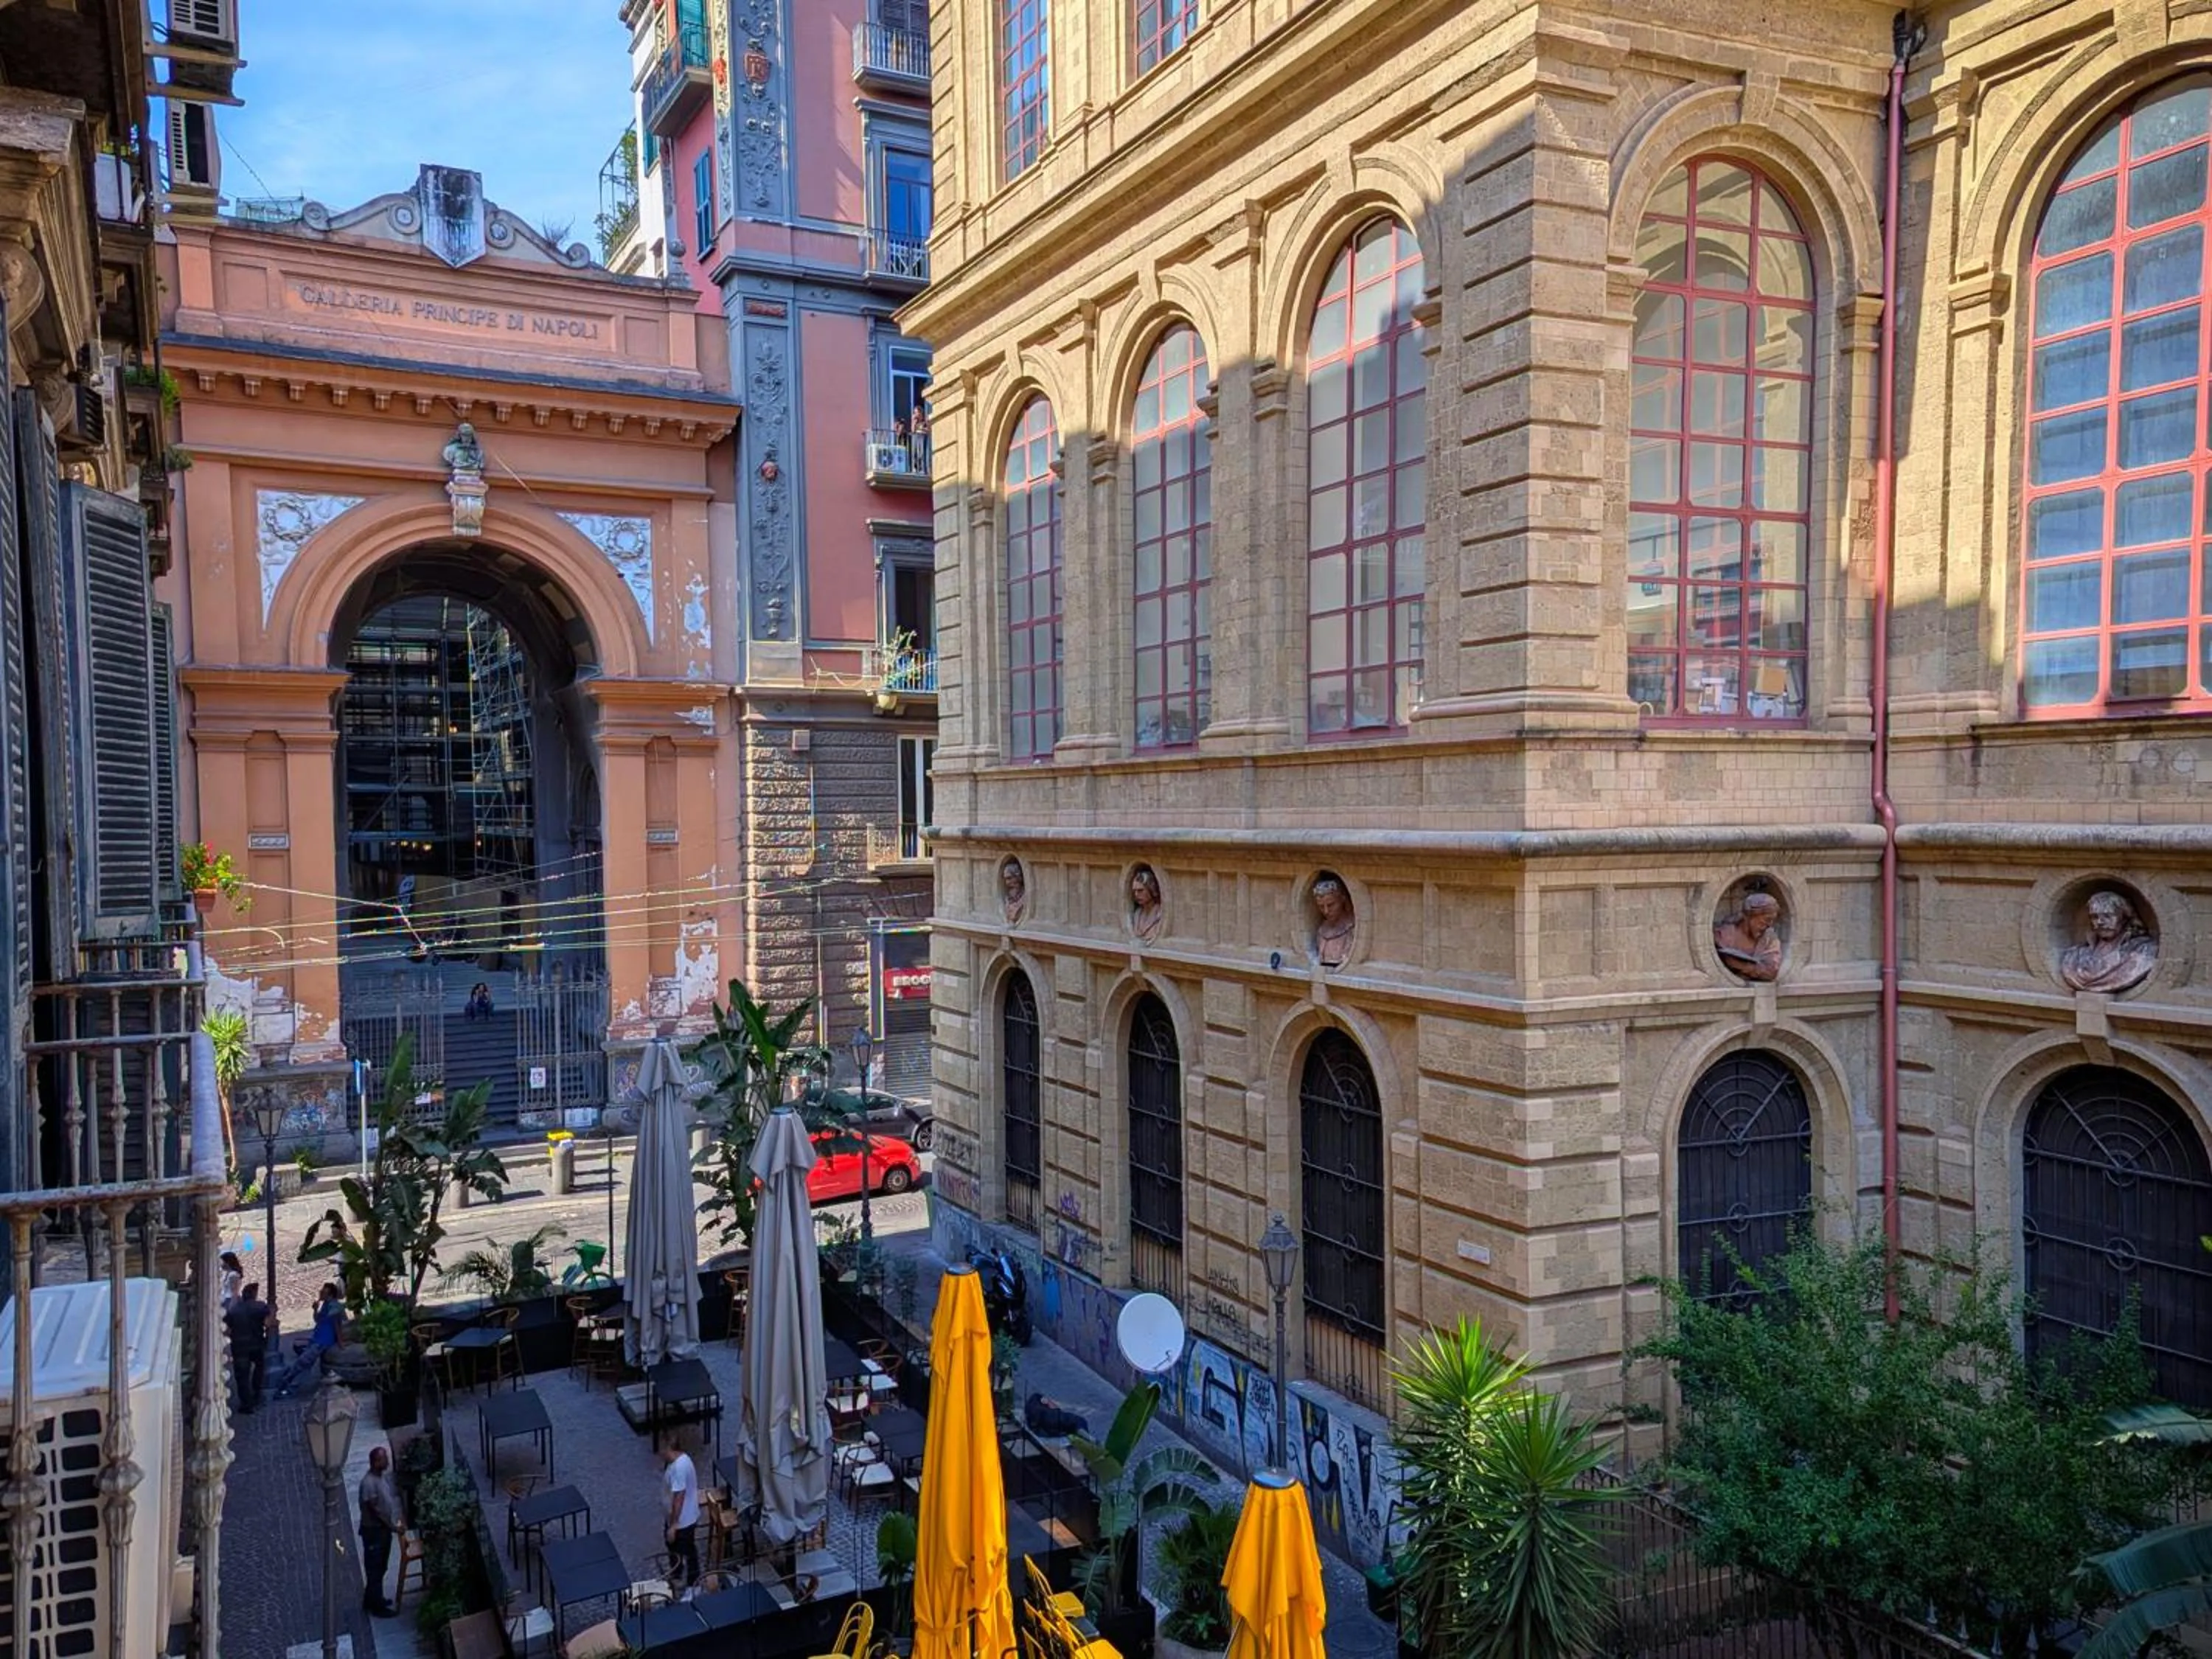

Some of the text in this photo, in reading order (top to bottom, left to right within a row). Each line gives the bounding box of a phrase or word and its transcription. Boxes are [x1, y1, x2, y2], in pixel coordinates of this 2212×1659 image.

[302, 285, 598, 340] GALLERIA PRINCIPE DI NAPOLI
